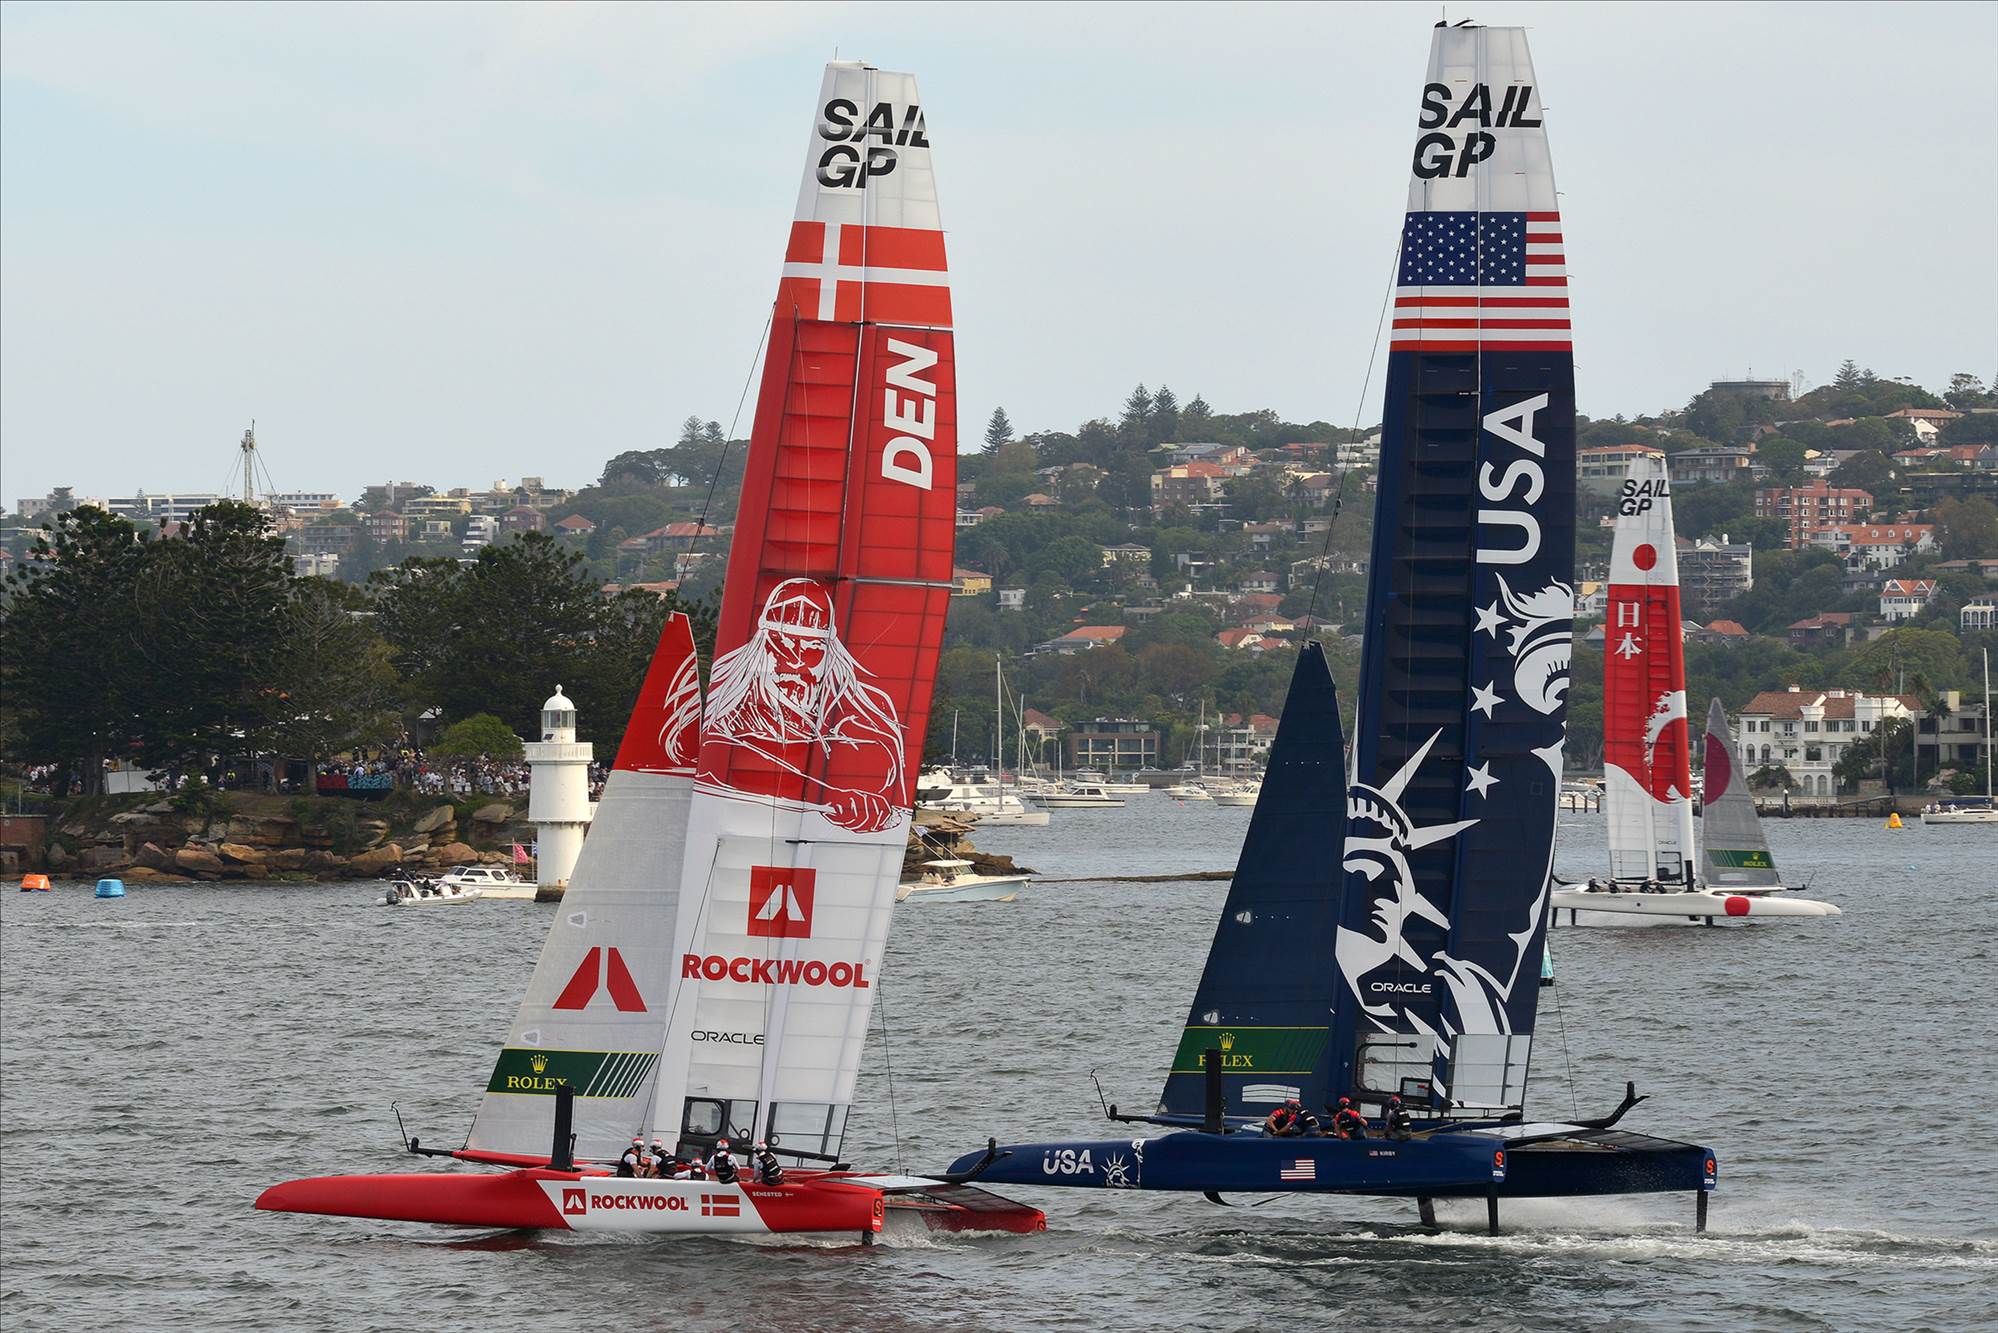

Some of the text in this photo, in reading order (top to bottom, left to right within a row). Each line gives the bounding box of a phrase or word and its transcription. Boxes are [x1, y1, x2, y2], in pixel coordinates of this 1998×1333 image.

[818, 98, 931, 148] SAIL
[1418, 83, 1542, 129] SAIL
[815, 145, 898, 188] GP
[1412, 131, 1496, 179] GP
[881, 337, 938, 491] DEN
[1476, 392, 1549, 564] USA
[1622, 479, 1671, 497] SAIL
[1620, 498, 1652, 516] GP
[1614, 601, 1643, 660] 日本
[681, 954, 869, 988] ROCKWOOL
[1370, 982, 1432, 993] ORACLE
[690, 1030, 764, 1045] ORACLE
[1198, 1054, 1253, 1067] RLEX
[1043, 1149, 1094, 1175] USA
[591, 1194, 688, 1211] ROCKWOOL
